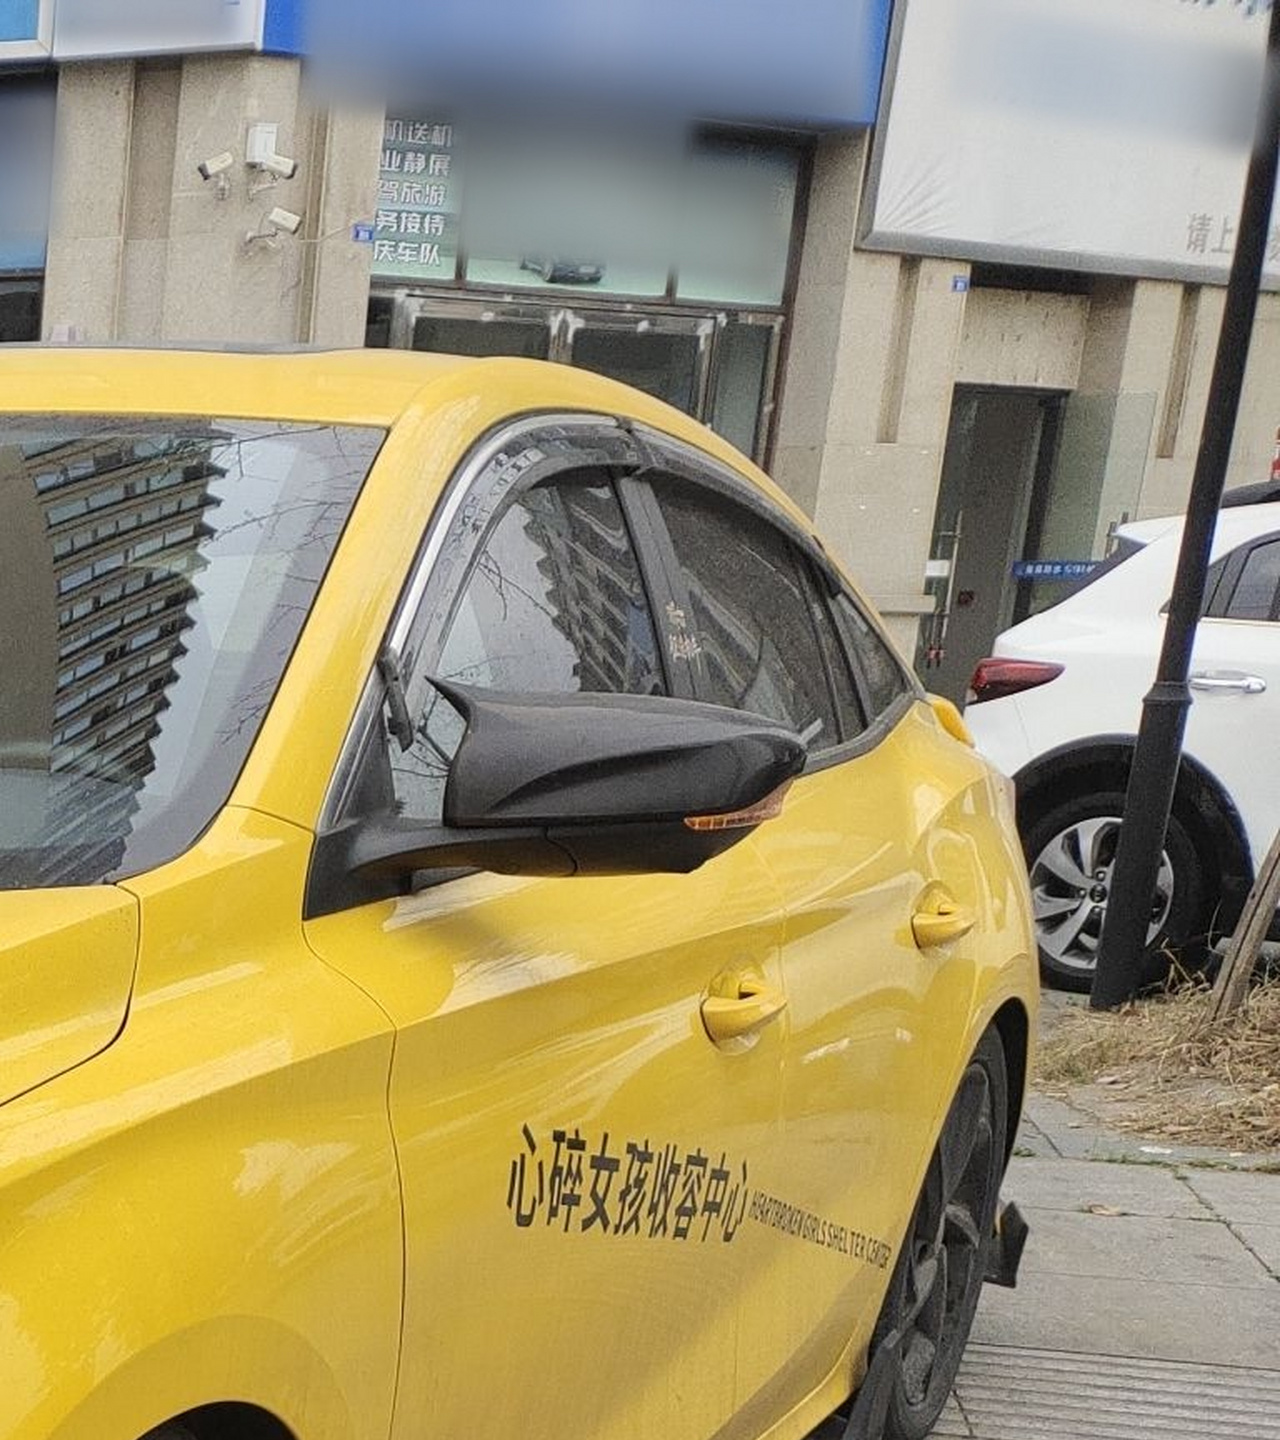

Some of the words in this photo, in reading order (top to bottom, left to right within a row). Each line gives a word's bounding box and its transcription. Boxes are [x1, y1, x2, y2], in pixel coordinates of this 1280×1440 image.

[507, 1123, 749, 1243] 心碎女孩收容中心
[826, 1220, 866, 1259] SHELTER
